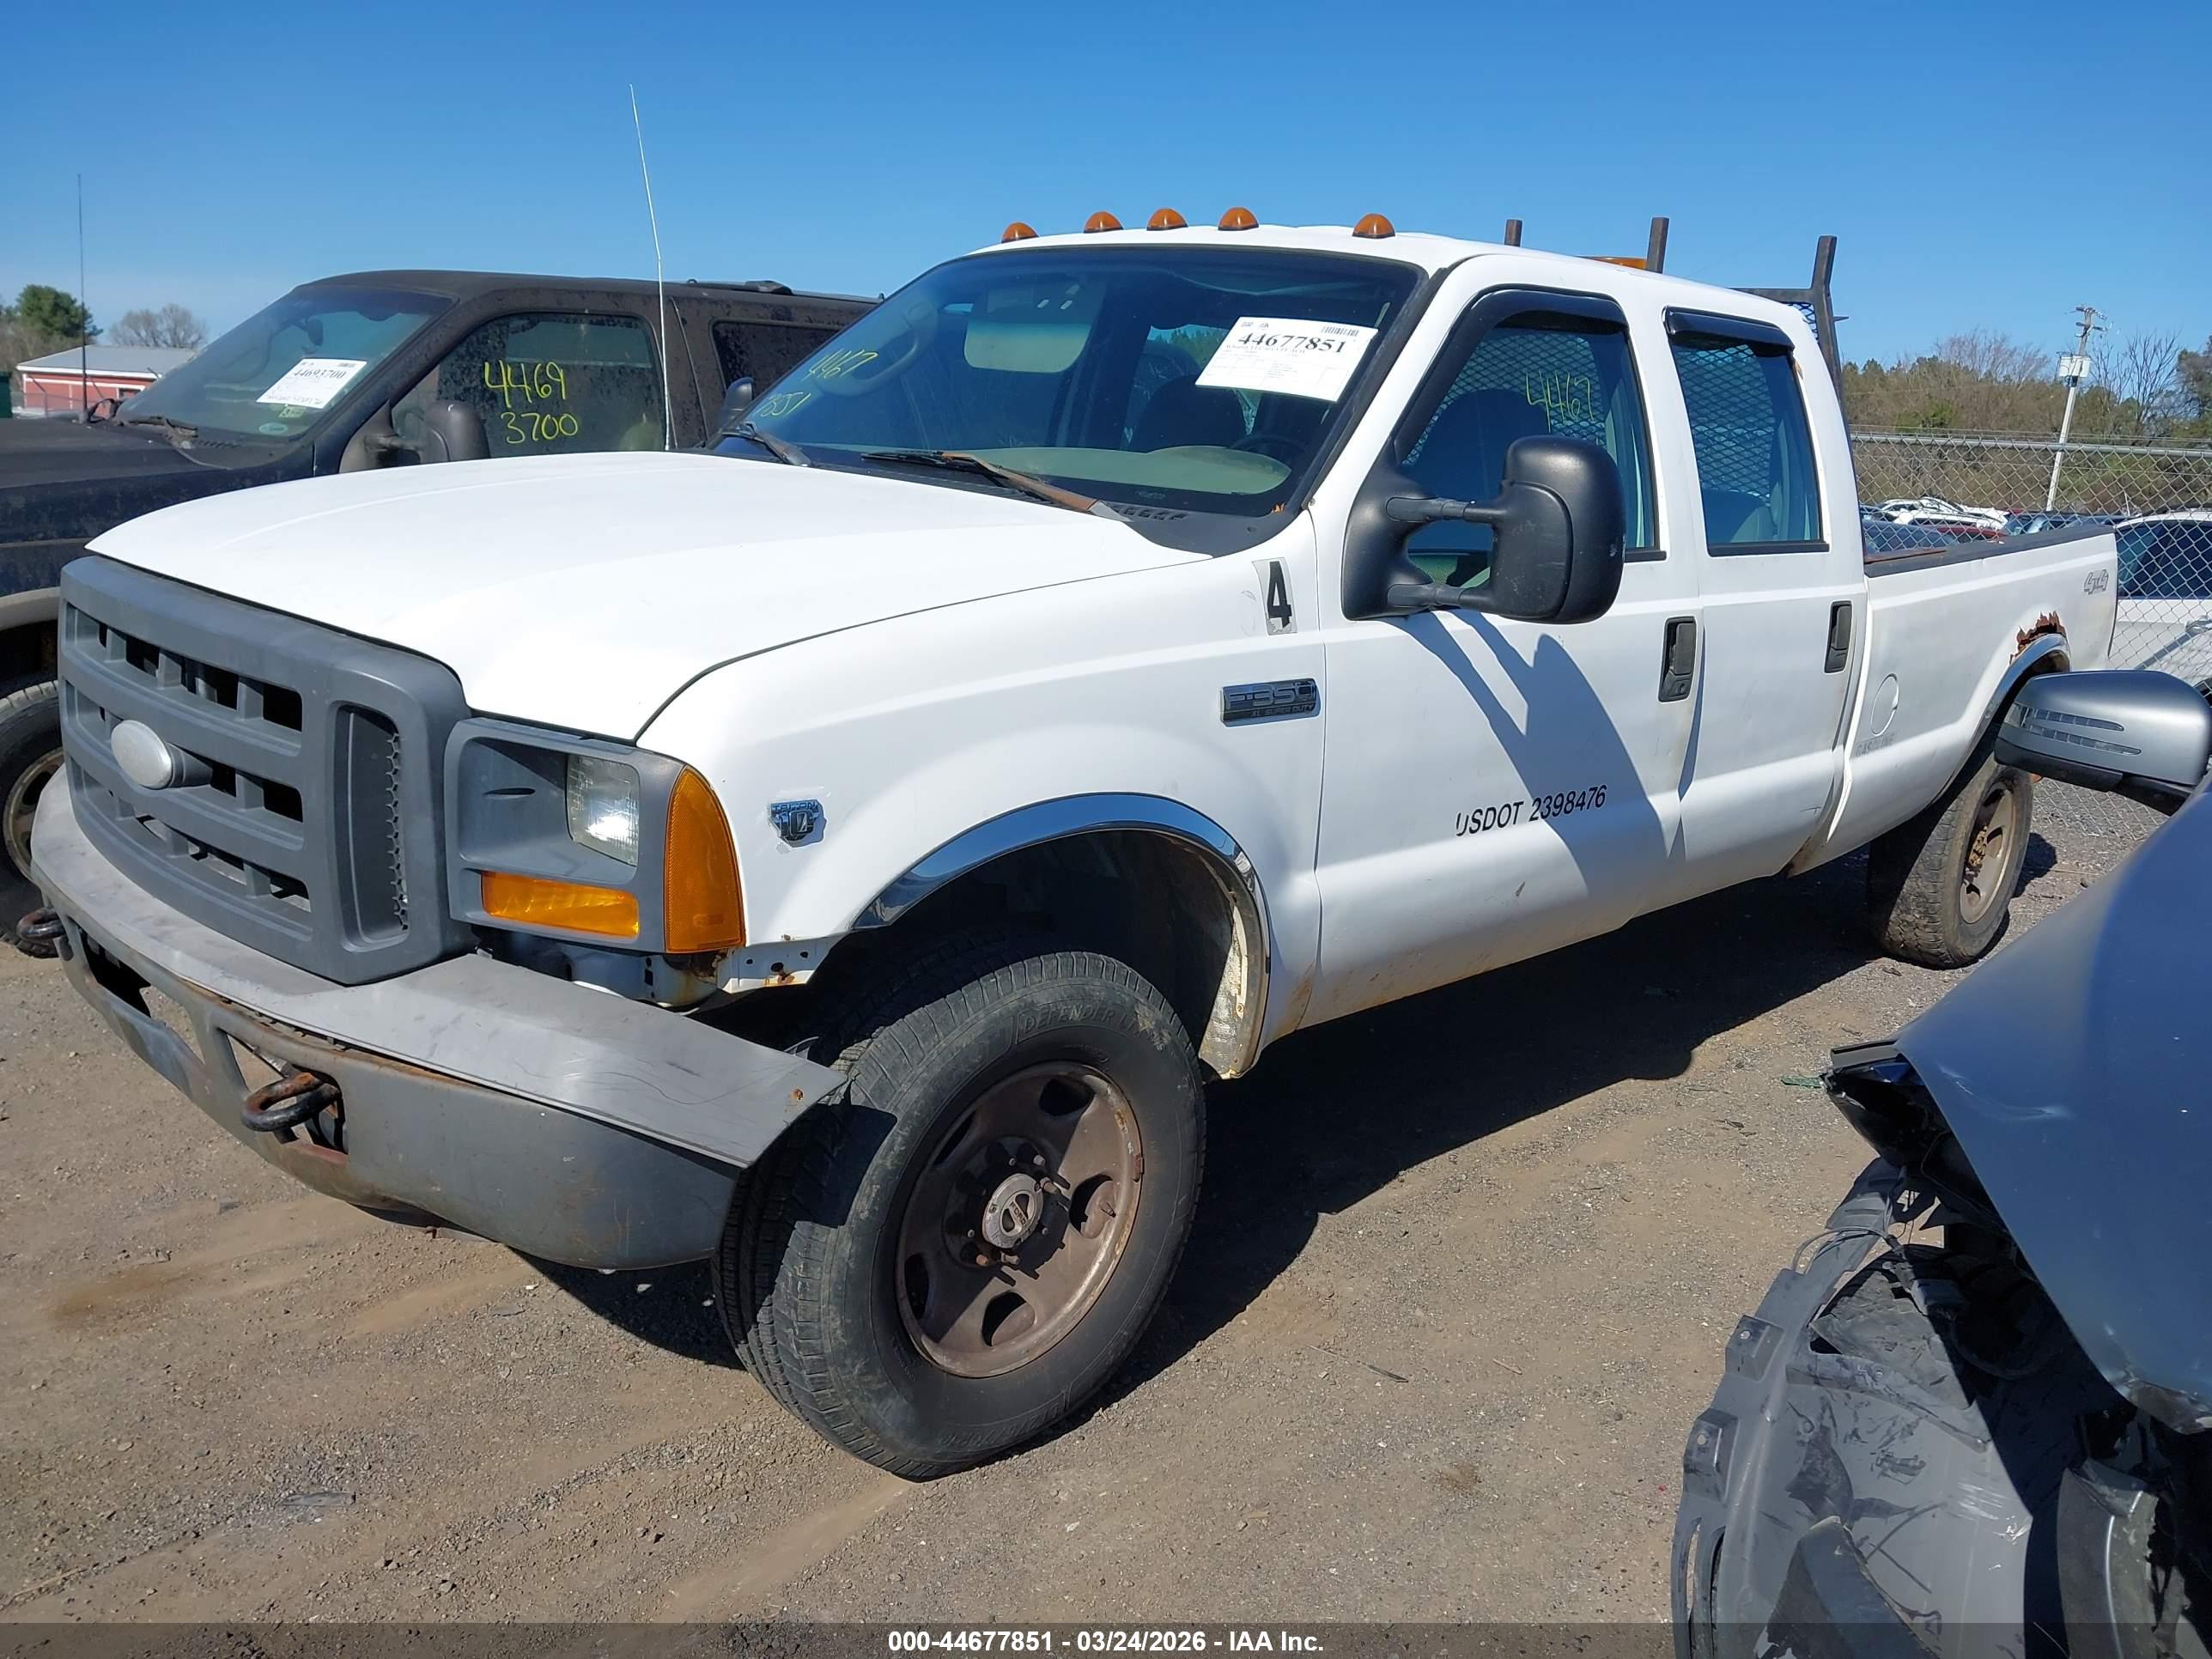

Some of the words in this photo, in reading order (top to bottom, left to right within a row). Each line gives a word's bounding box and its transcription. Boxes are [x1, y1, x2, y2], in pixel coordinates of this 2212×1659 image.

[801, 349, 878, 381] 4467
[1237, 332, 1347, 353] 44677851
[484, 360, 566, 408] 4469
[1525, 370, 1595, 433] 4467
[501, 412, 578, 443] 3700
[1267, 561, 1292, 629] 4
[1455, 801, 1524, 836] USDOT
[1528, 776, 1607, 822] 2398476
